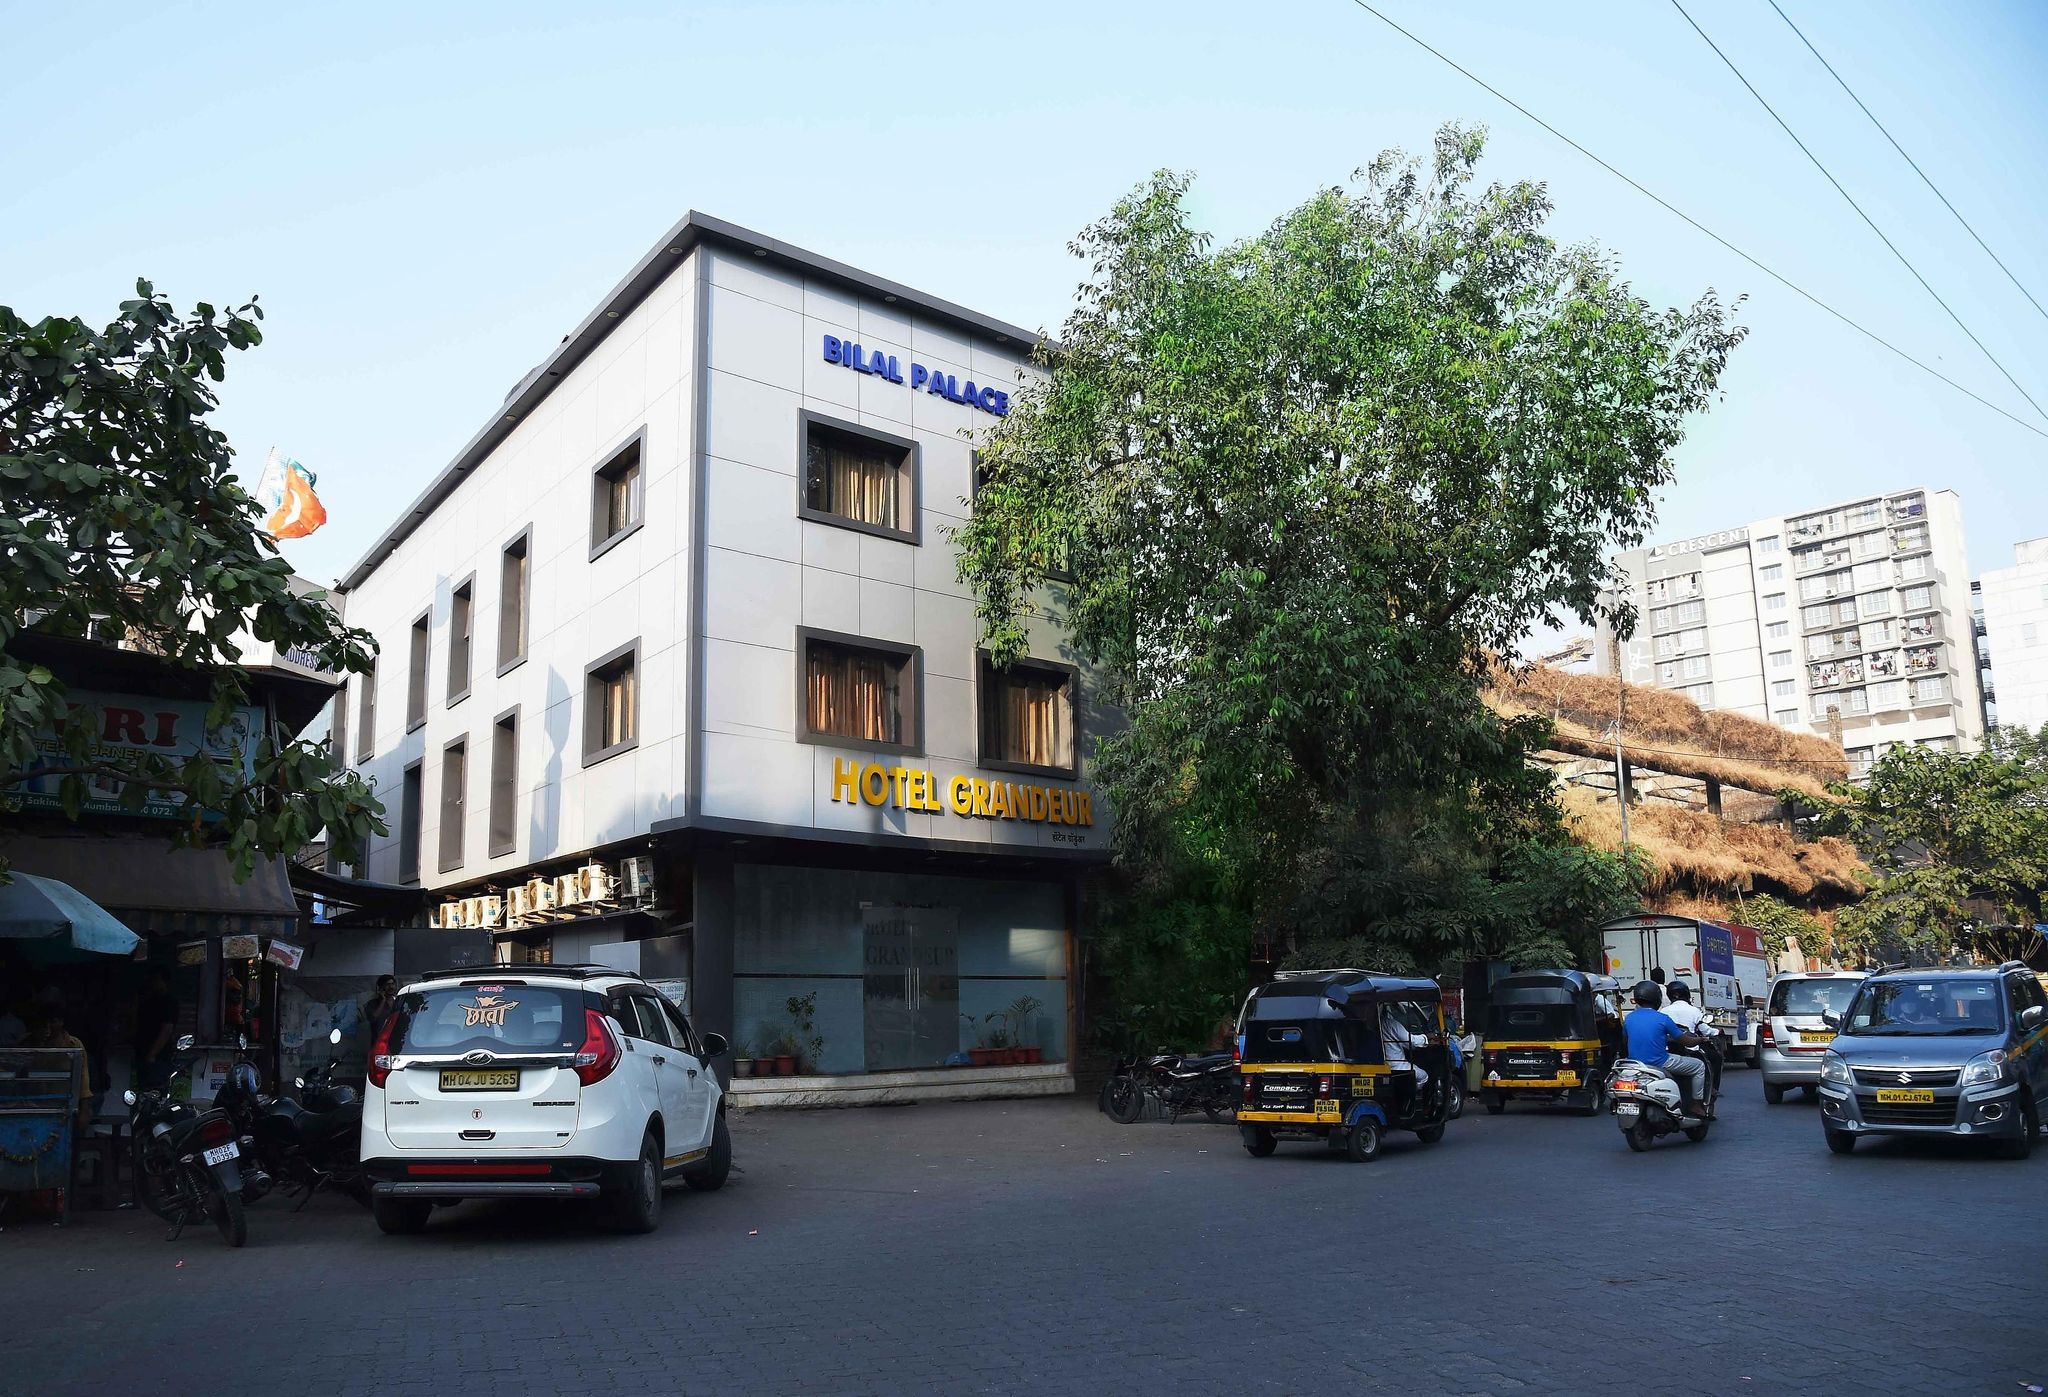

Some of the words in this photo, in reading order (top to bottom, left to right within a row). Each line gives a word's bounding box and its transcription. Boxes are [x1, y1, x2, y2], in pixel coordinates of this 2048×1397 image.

[823, 334, 904, 385] BILAL
[911, 362, 1009, 416] PALACE
[1667, 527, 1749, 557] CRESCENT
[832, 756, 942, 812] HOTEL
[949, 773, 1094, 827] GRANDEUR
[442, 1074, 456, 1086] MH
[458, 1073, 471, 1086] 04
[473, 1073, 486, 1085] JU
[490, 1072, 516, 1085] 5265
